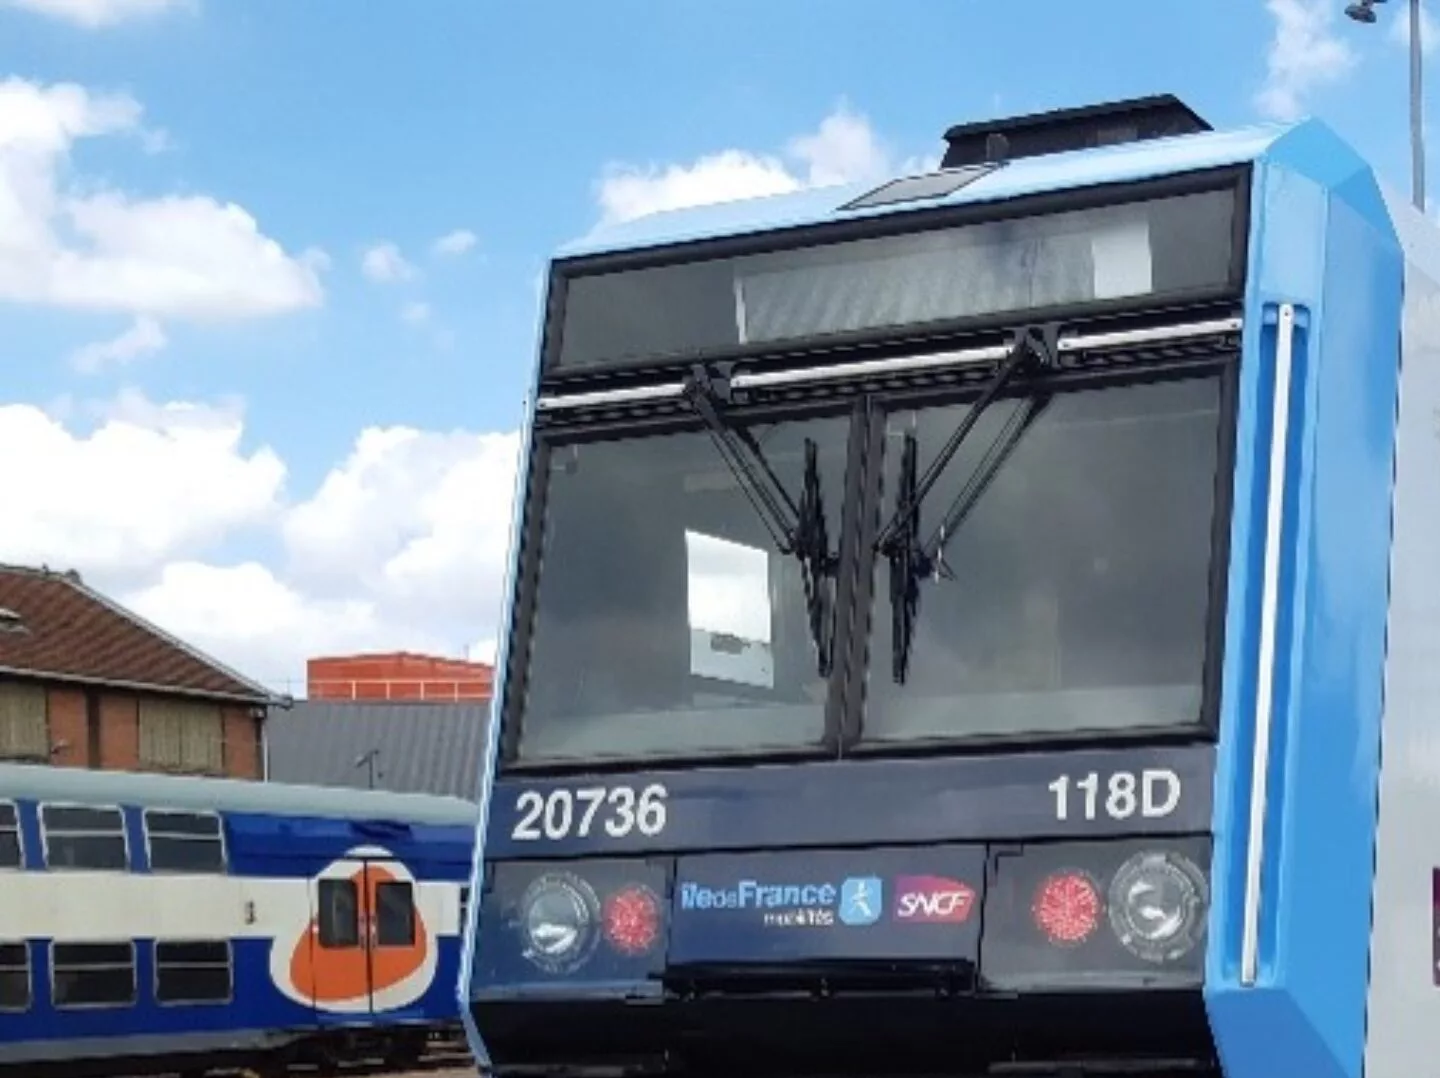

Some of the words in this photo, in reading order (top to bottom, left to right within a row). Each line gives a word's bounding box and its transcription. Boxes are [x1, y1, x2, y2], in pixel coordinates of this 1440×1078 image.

[511, 783, 669, 841] 20736
[1048, 769, 1182, 821] 118D
[896, 890, 969, 918] SNCF
